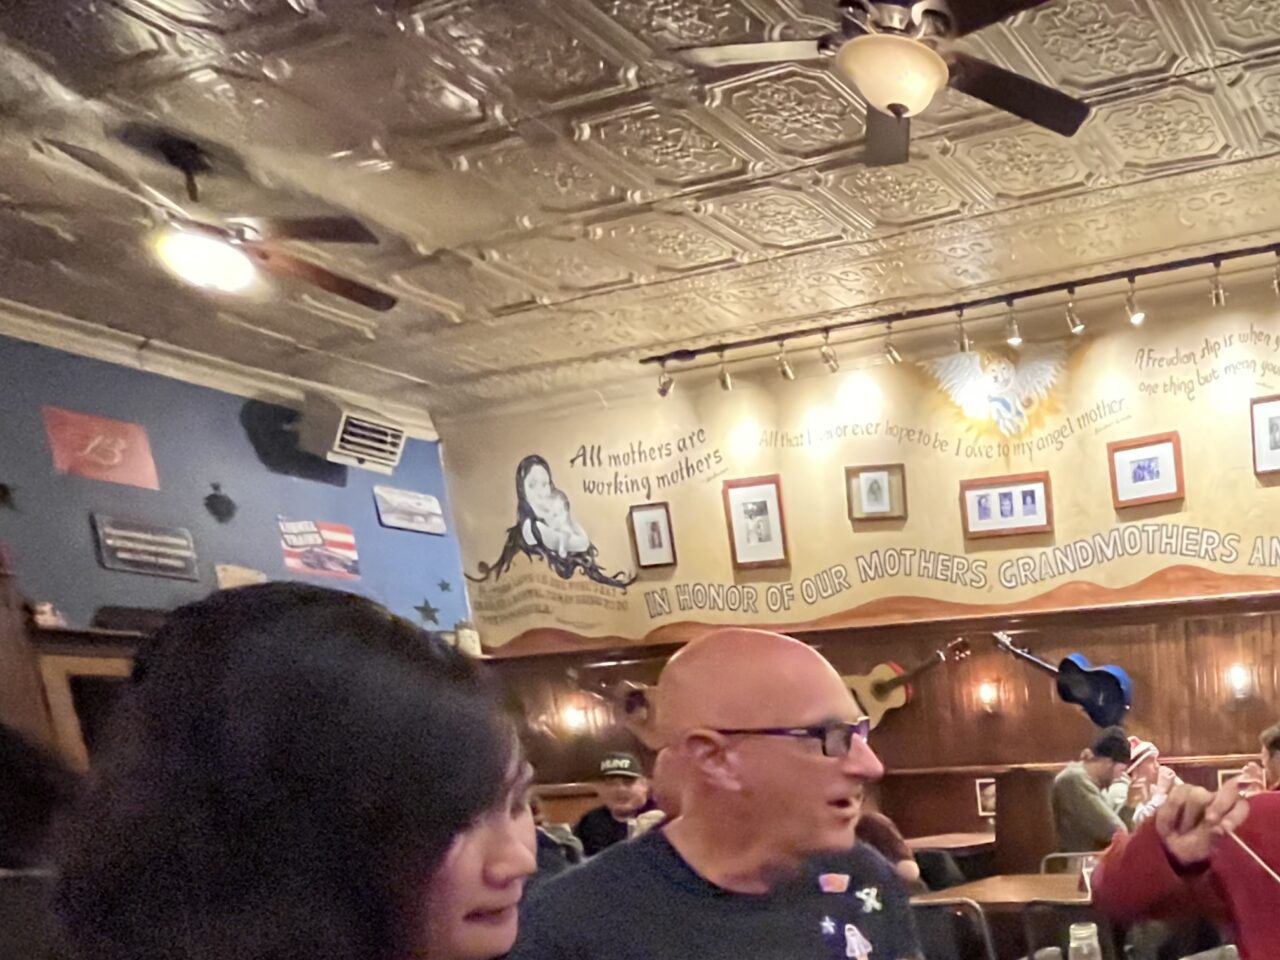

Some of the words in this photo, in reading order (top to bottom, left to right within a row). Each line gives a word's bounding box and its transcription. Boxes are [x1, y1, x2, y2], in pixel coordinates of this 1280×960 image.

[1145, 347, 1198, 369] Freudian
[1200, 338, 1221, 359] slip
[1223, 334, 1234, 348] is
[1238, 322, 1271, 346] when
[1138, 380, 1159, 394] one
[1162, 375, 1196, 401] thing
[1196, 369, 1220, 387] but
[1223, 358, 1257, 376] mean
[569, 444, 603, 468] All
[607, 440, 673, 468] mothers
[676, 428, 707, 453] are
[758, 430, 779, 447] All
[780, 430, 805, 448] that
[835, 424, 849, 438] or
[851, 422, 882, 436] ever
[885, 420, 918, 443] hope
[917, 428, 932, 447] to
[932, 432, 949, 453] be
[965, 445, 994, 459] owe
[997, 443, 1010, 459] to
[1012, 438, 1034, 463] my
[1036, 418, 1075, 452] angel
[582, 471, 652, 501] working
[656, 448, 723, 490] mothers
[643, 586, 672, 618] IN
[675, 582, 759, 614] HONOR
[765, 583, 795, 613] OF
[801, 563, 851, 606] OUR
[998, 522, 1241, 590] GRANDMOTHERS
